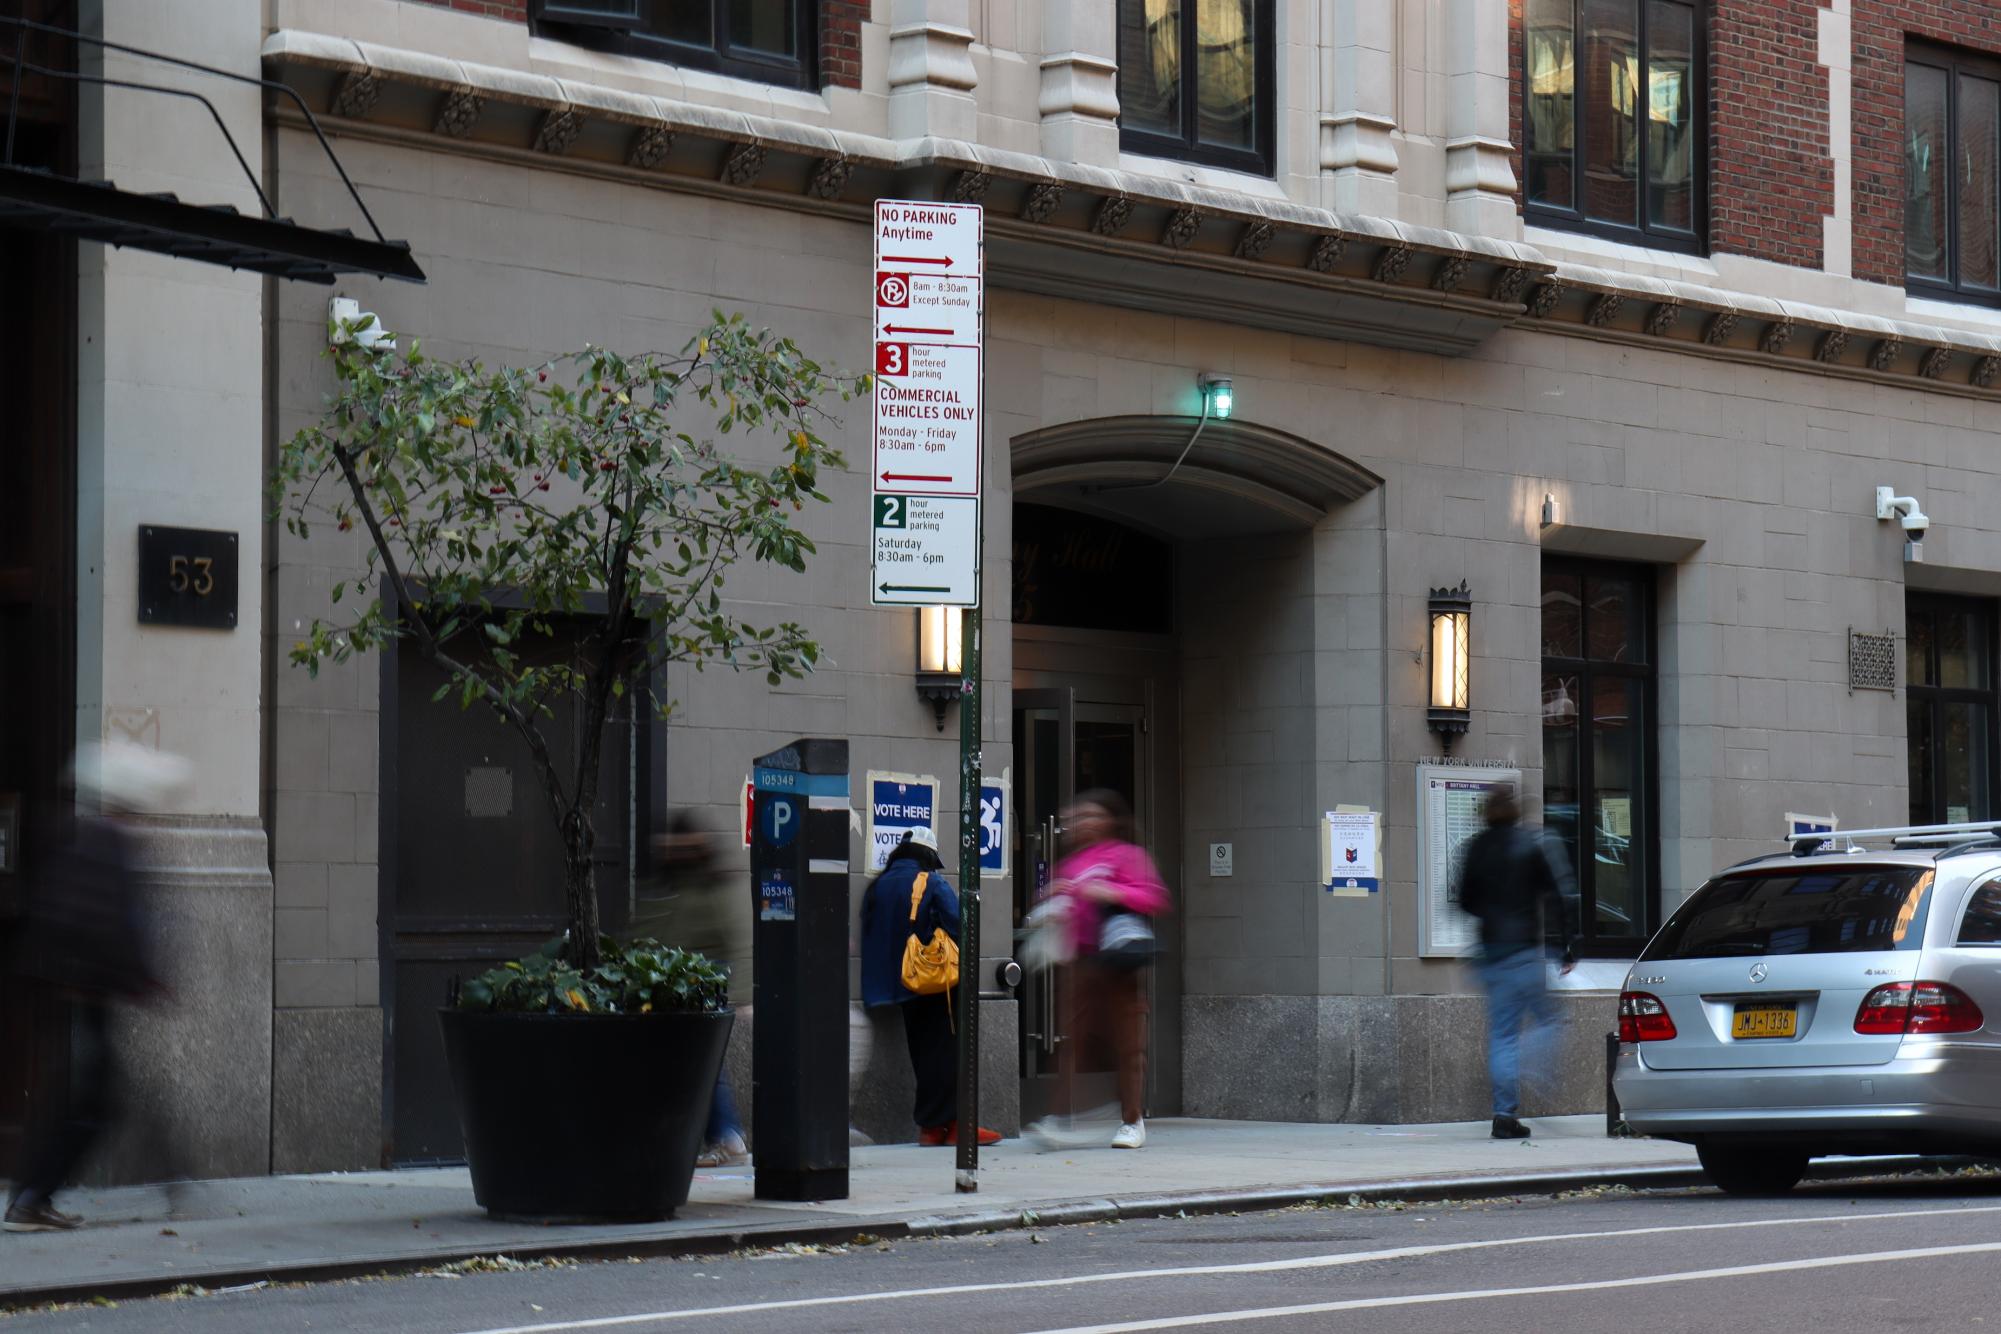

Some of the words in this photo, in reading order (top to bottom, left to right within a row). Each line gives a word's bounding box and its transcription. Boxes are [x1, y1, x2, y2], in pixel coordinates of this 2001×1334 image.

[882, 209, 899, 221] NO
[904, 210, 957, 225] PARKING
[882, 225, 933, 242] Anytime
[913, 282, 930, 291] 8am
[938, 283, 968, 293] 8:30am
[913, 295, 939, 306] Except
[942, 296, 970, 308] Sunday
[912, 347, 930, 356] hour
[885, 345, 902, 374] 3
[912, 358, 946, 368] metered
[912, 369, 942, 380] parking
[880, 387, 961, 403] COMMERCIAL
[881, 404, 939, 419] VEHICLES
[943, 406, 974, 420] ONLY
[879, 426, 917, 440] Monday
[927, 427, 957, 441] Friday
[879, 439, 915, 451] 8:30am
[924, 440, 946, 453] 6pm
[910, 499, 928, 508] hour
[883, 497, 899, 526] 2
[910, 510, 944, 519] metered
[910, 521, 940, 531] parking
[878, 537, 922, 550] Saturday
[878, 551, 913, 562] 8:30am
[923, 552, 944, 565] 6pm
[170, 555, 213, 595] 53
[1419, 755, 1440, 766] NEW
[1443, 757, 1465, 768] YORK
[762, 774, 794, 786] 105348
[874, 803, 901, 817] VOTE
[902, 805, 930, 819] HERE
[774, 801, 792, 839] P
[875, 832, 901, 845] VOTE
[762, 886, 792, 897] 105348
